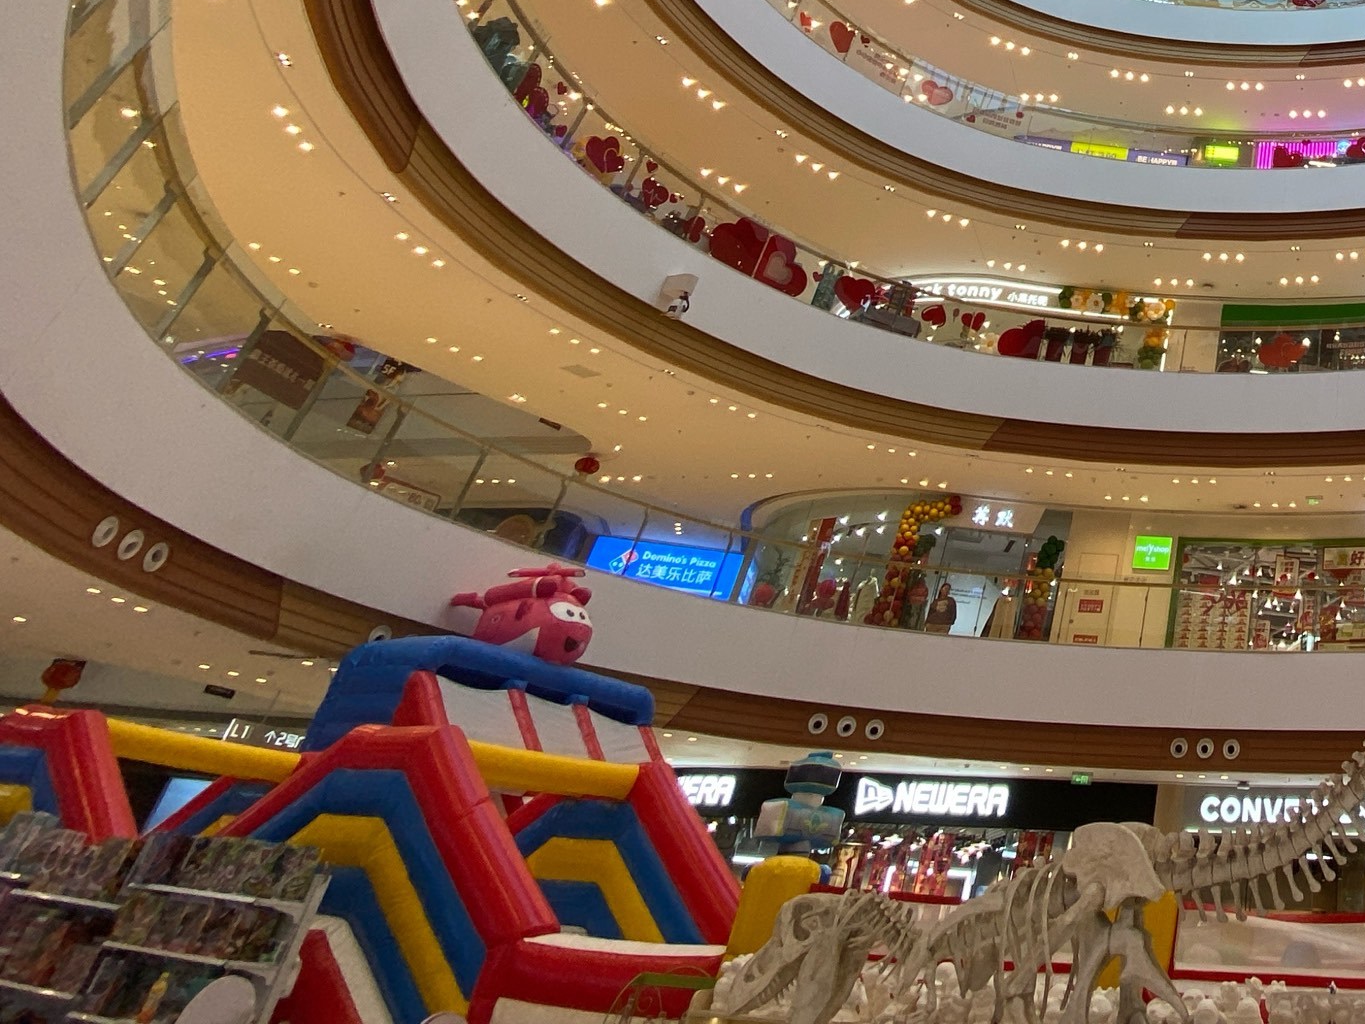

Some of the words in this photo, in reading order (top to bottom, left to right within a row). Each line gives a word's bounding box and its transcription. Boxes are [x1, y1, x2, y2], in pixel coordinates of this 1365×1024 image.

[947, 284, 1003, 301] tonny
[642, 550, 687, 565] Domino's
[689, 556, 717, 568] Pizza
[636, 563, 714, 585] 达美乐比萨
